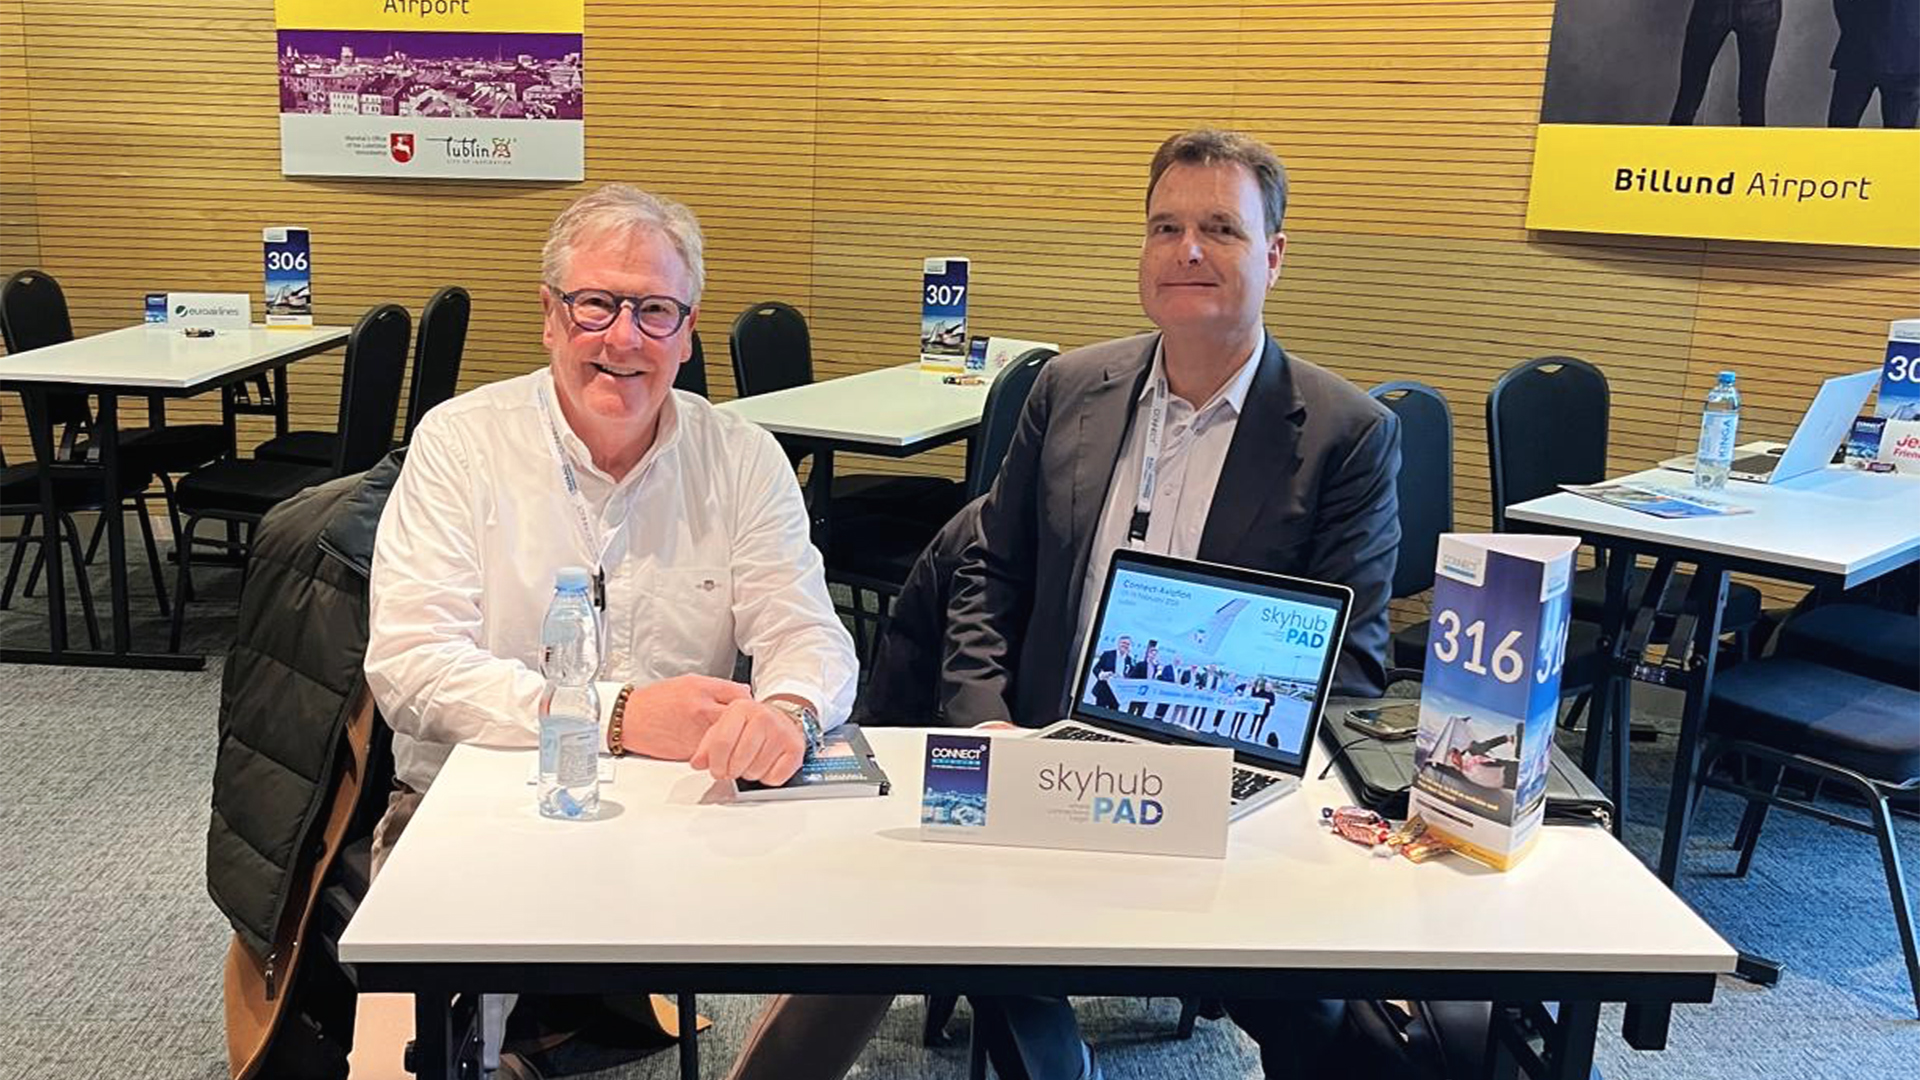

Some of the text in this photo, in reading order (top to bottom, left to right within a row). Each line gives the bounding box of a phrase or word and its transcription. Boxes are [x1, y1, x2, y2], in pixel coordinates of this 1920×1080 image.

[383, 0, 470, 18] Airport
[1614, 168, 1872, 202] Billund Airport
[267, 251, 308, 271] 306
[925, 284, 965, 306] 307
[1896, 434, 1920, 449] Je
[1261, 606, 1328, 632] skyhub
[1285, 628, 1324, 648] PAD
[1433, 609, 1524, 683] 316
[931, 748, 982, 759] CONNECT
[1038, 763, 1164, 801] skyhub
[1092, 797, 1165, 826] PAD
